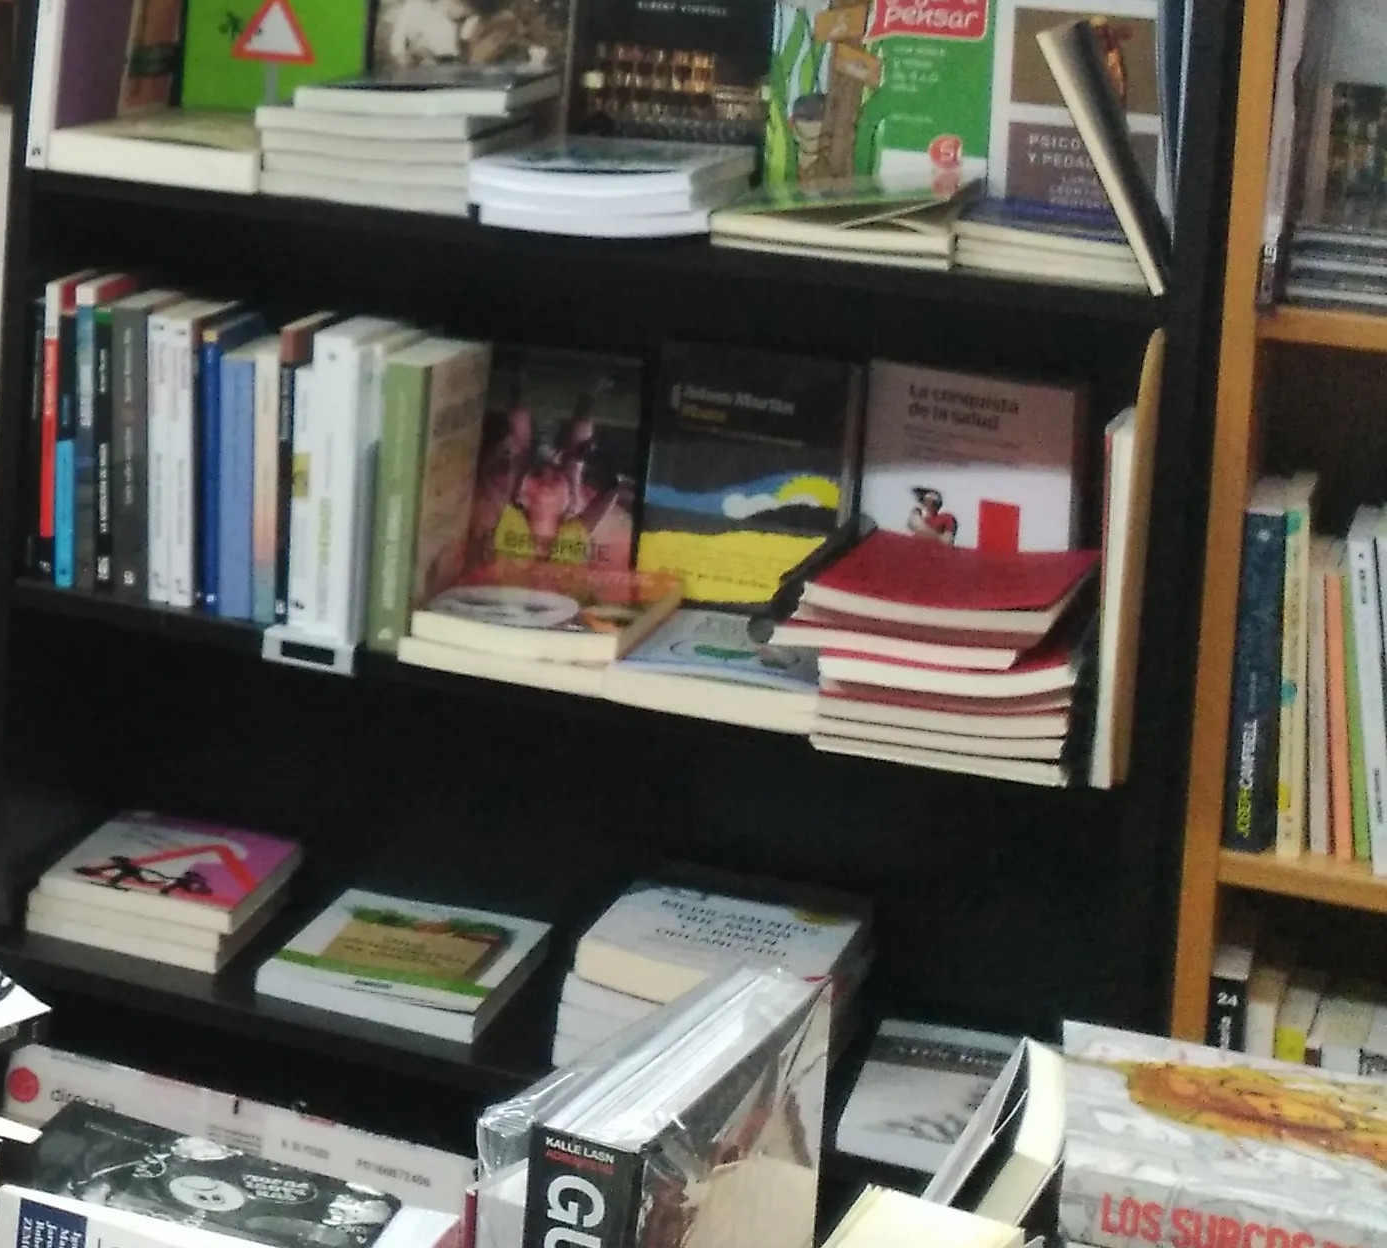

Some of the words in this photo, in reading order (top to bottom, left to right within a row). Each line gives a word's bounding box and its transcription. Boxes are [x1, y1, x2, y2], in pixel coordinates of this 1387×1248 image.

[545, 1136, 582, 1156] KALLE
[583, 1146, 616, 1165] LASN
[1100, 1191, 1165, 1242] LOS
